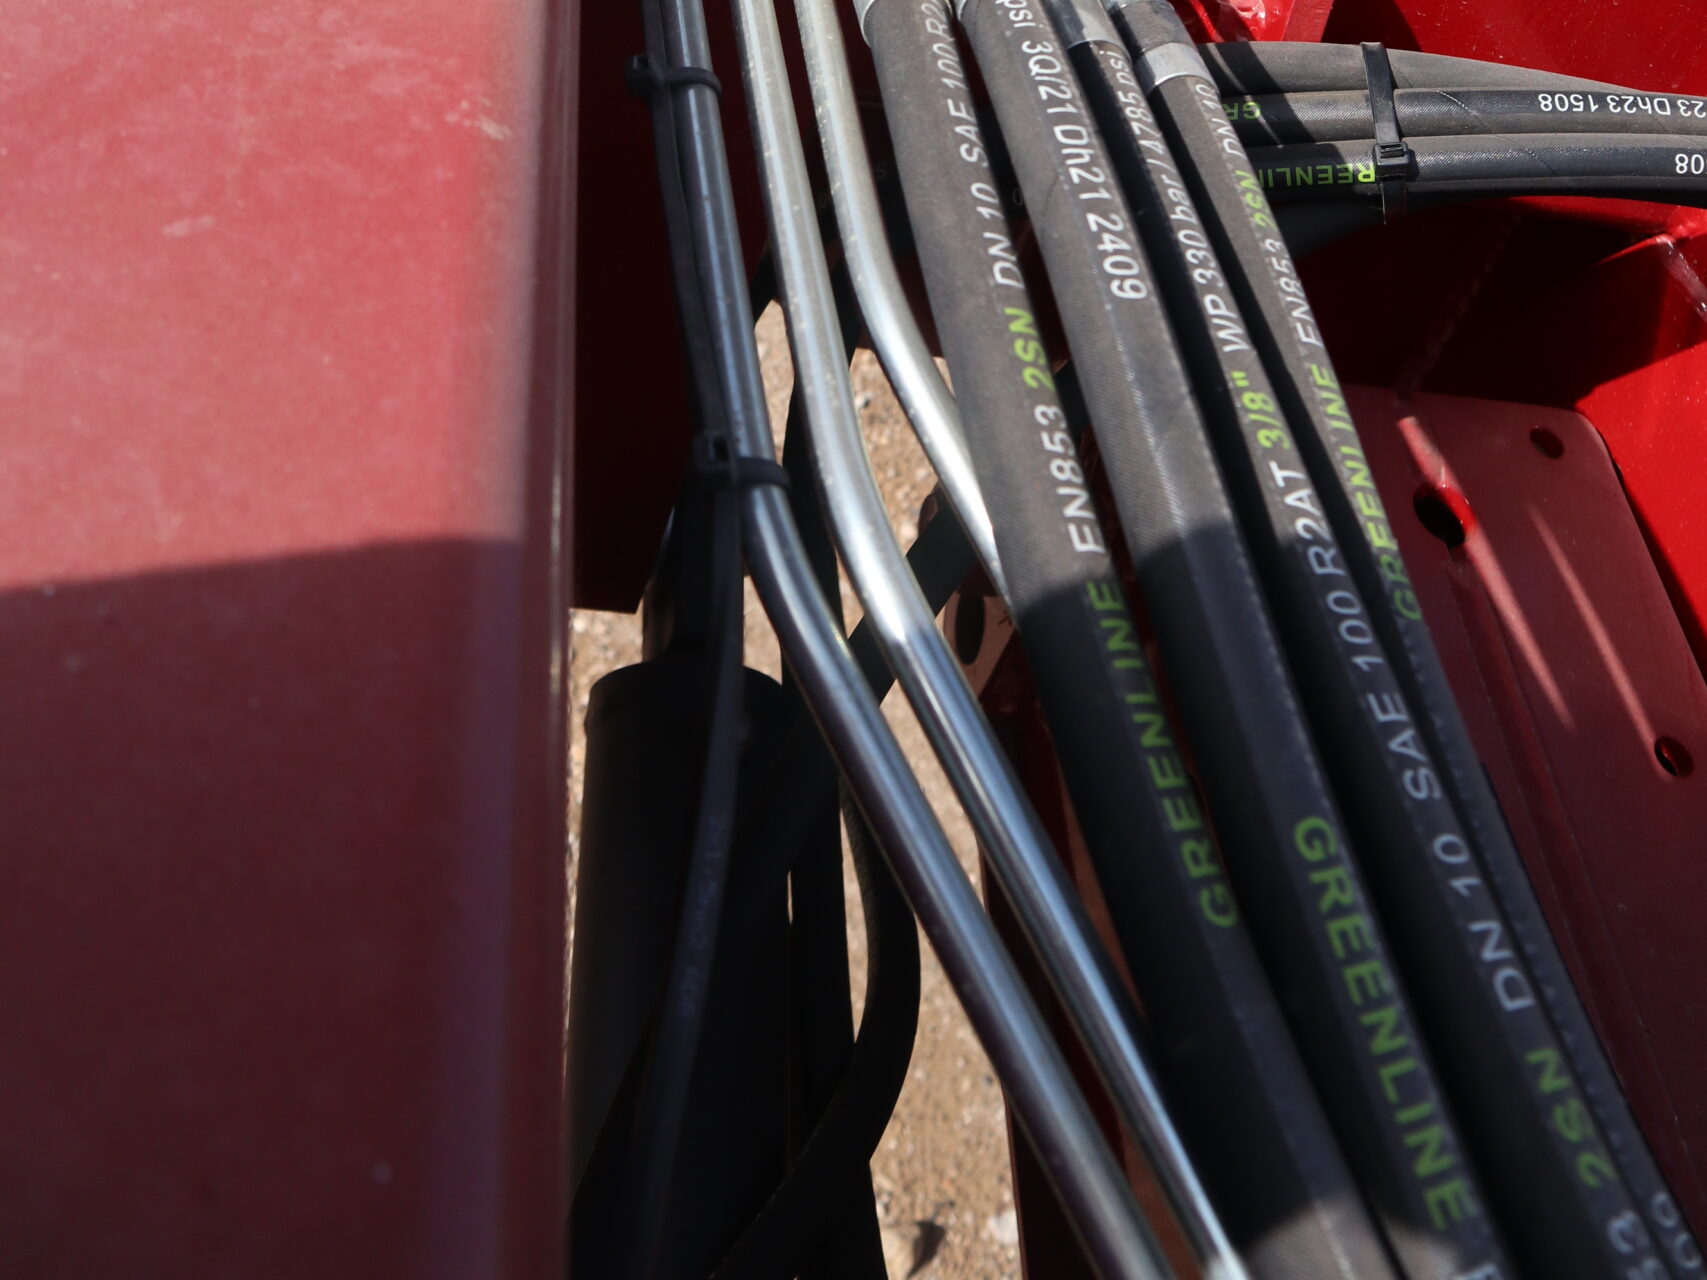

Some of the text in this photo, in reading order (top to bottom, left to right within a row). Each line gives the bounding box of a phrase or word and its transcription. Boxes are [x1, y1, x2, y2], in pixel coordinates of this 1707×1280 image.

[1116, 91, 1166, 157] 4785
[1538, 92, 1599, 113] 1508
[1606, 95, 1671, 115] Dh23
[970, 182, 1002, 219] 10
[1021, 40, 1072, 115] 3Q/21
[1053, 125, 1113, 203] Dh21
[1086, 212, 1148, 300] 2409
[1160, 174, 1200, 224] bar
[983, 231, 1025, 289] DN
[1178, 230, 1225, 288] 330
[1003, 306, 1055, 392] 2SN
[1203, 293, 1250, 353] WP
[1231, 371, 1291, 450] 3/8"
[1033, 404, 1106, 554] EN853
[1269, 460, 1345, 576] R2AT
[1326, 590, 1386, 672] 100
[1086, 581, 1239, 928] GREENLINE
[1367, 691, 1443, 802] SAE
[1432, 833, 1483, 898] 10
[1468, 919, 1535, 1012] DN
[1293, 816, 1477, 1231] GREENLINE
[1526, 1047, 1617, 1188] 2SN
